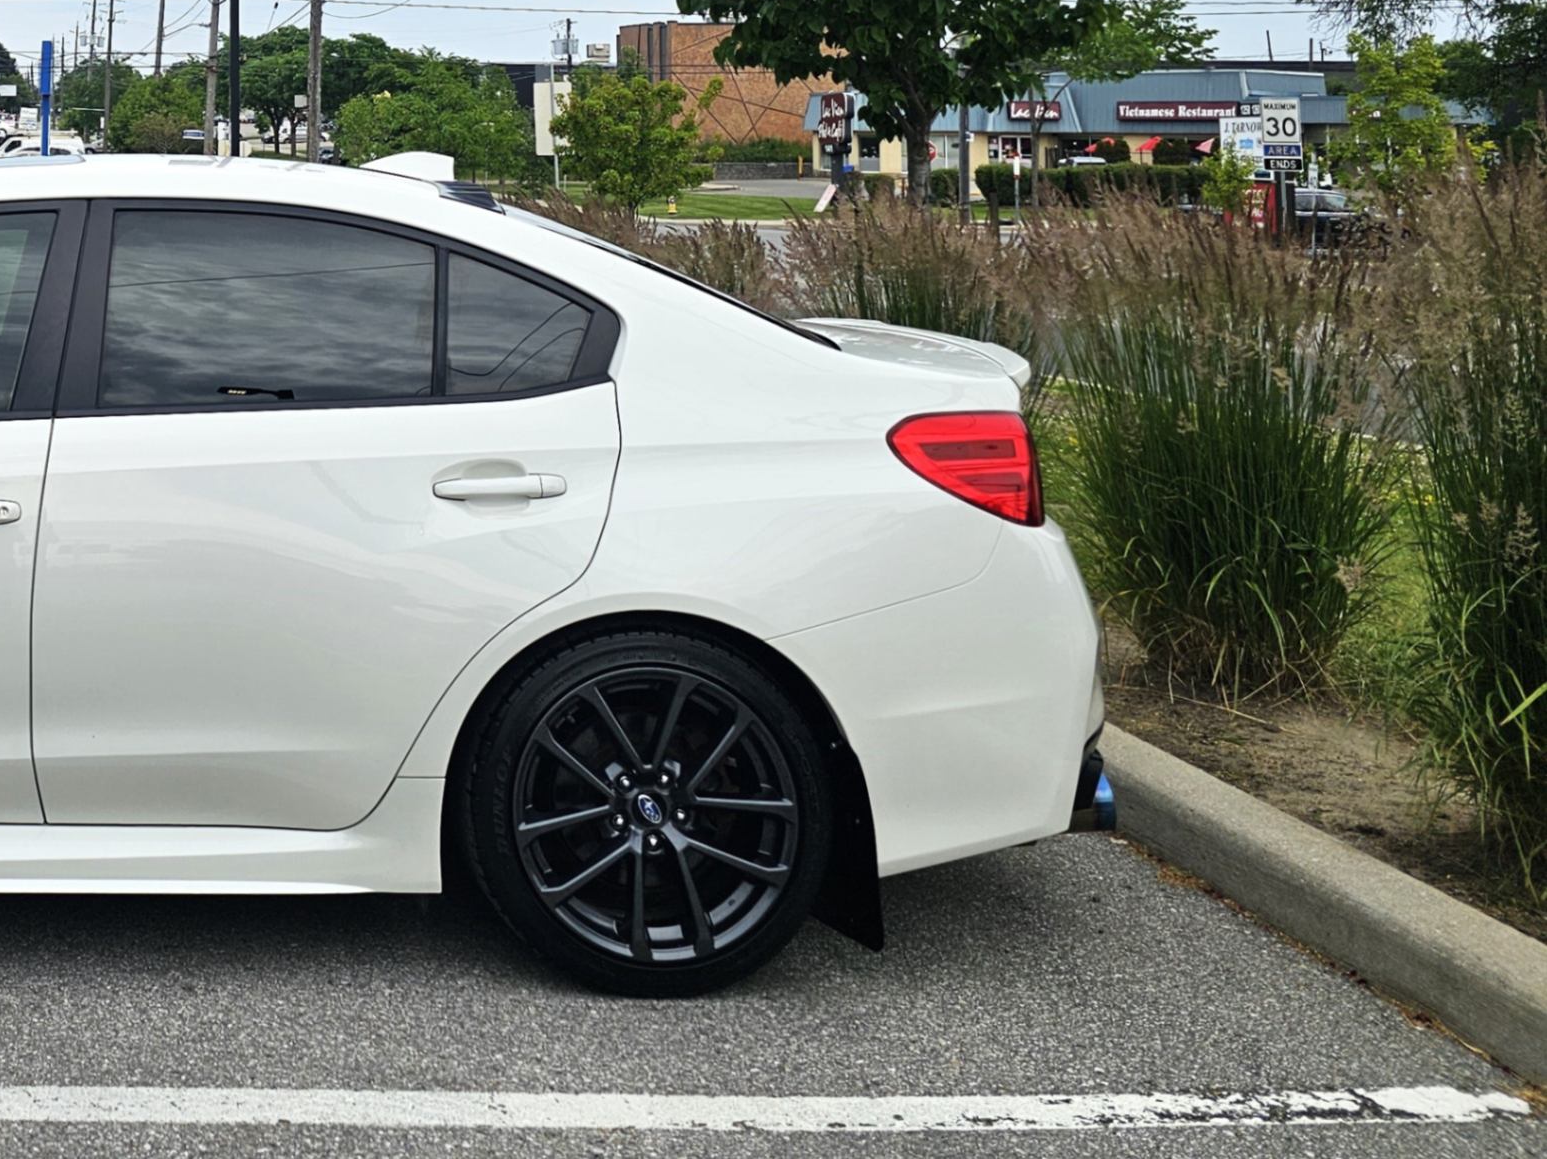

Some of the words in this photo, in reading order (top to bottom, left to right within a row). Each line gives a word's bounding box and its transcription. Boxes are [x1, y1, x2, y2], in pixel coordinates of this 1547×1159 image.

[1118, 105, 1175, 118] Vietnamese
[1178, 105, 1237, 118] Restaurant
[1263, 103, 1296, 111] MAXIMUM
[1266, 116, 1297, 137] 30
[1268, 146, 1298, 155] AREA
[1269, 160, 1297, 169] ENDS
